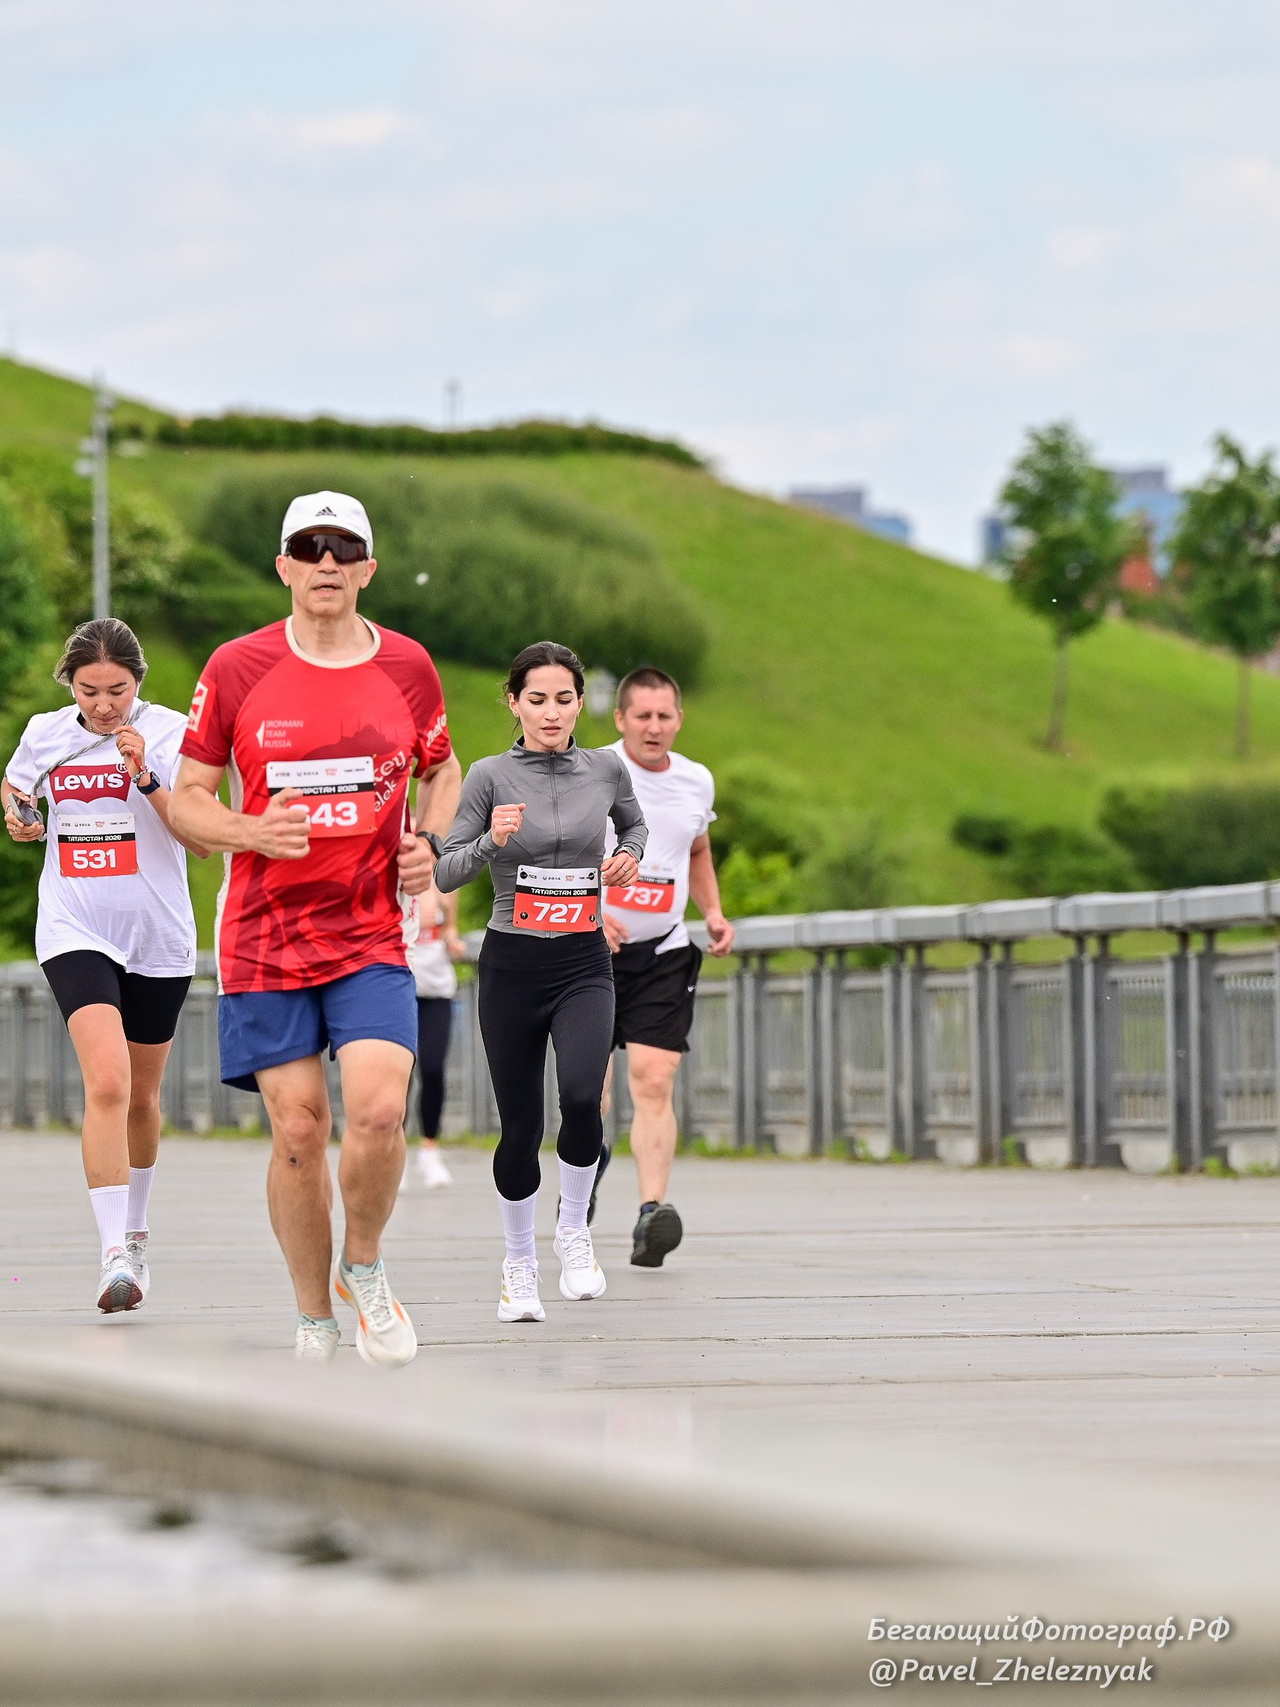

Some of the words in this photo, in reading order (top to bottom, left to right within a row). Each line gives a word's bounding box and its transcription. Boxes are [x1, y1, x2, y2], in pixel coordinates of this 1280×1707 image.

[265, 720, 304, 728] IRONMAN
[264, 740, 292, 748] RUSSIA
[73, 848, 116, 869] 531
[530, 887, 572, 896] ТАТАРСТАН
[621, 886, 665, 907] 737
[533, 901, 584, 924] 727
